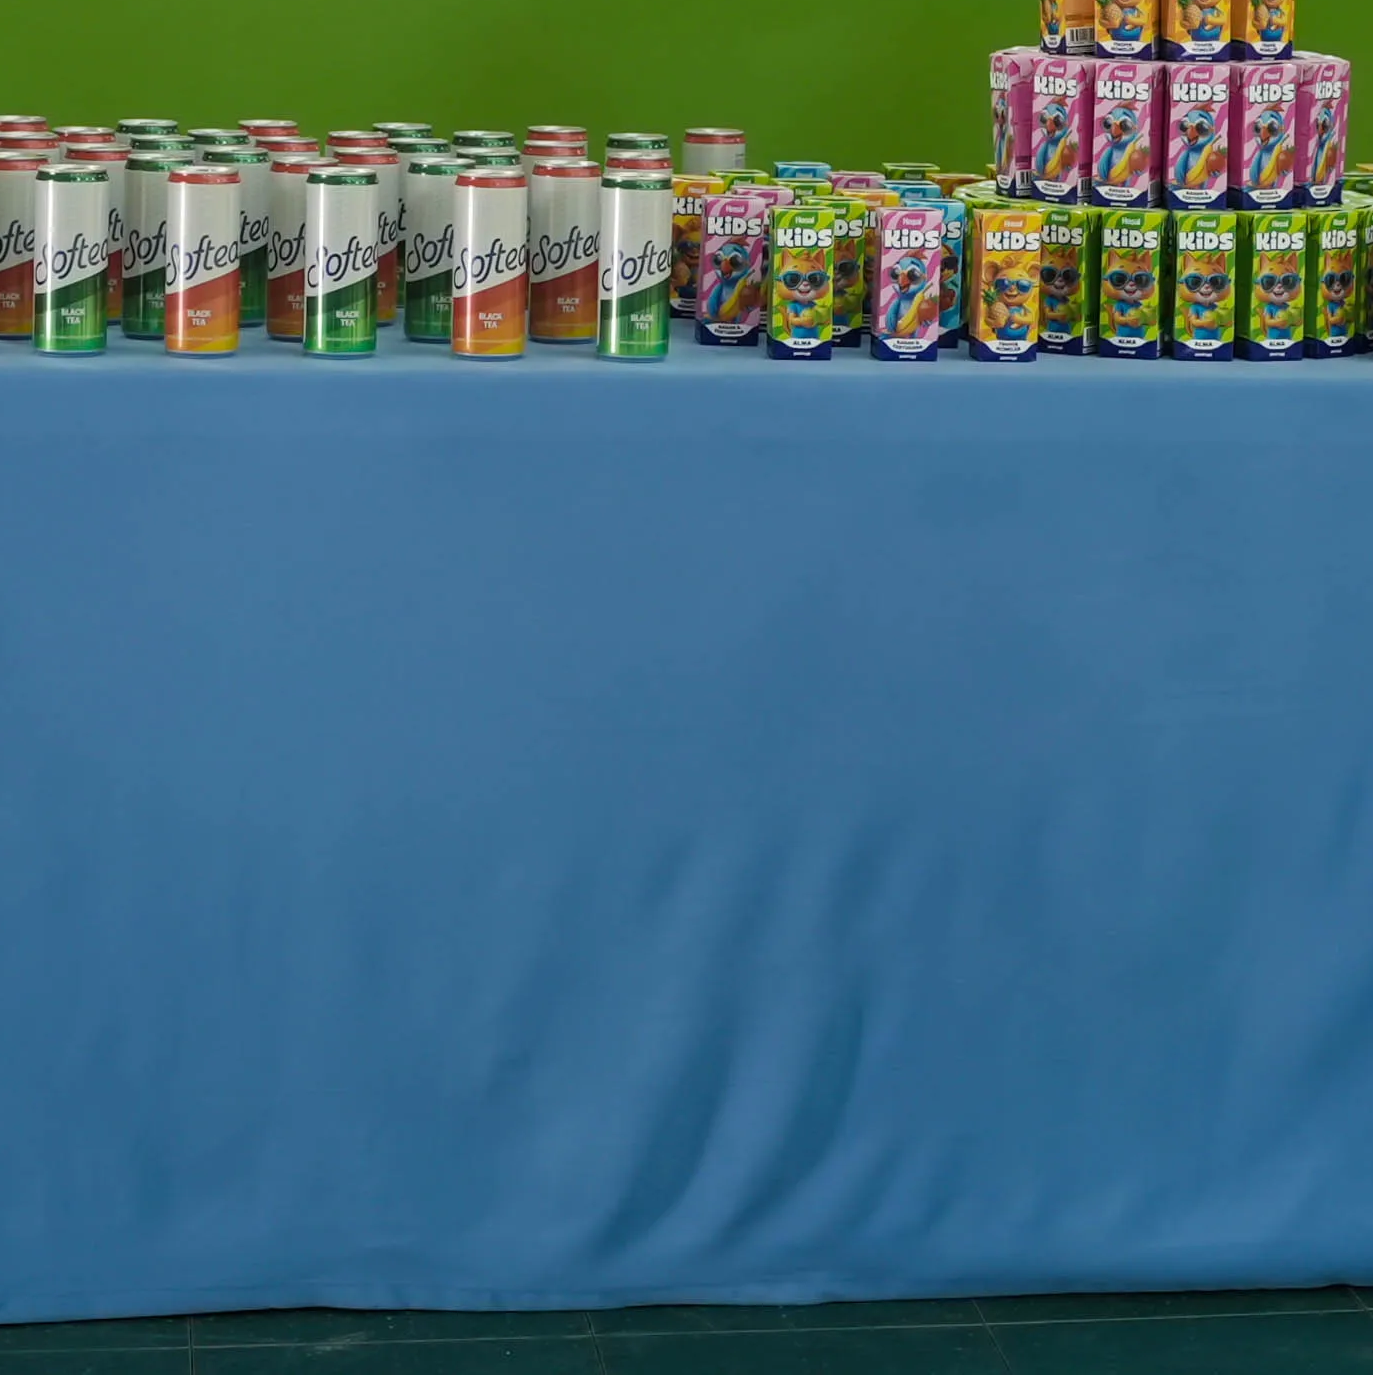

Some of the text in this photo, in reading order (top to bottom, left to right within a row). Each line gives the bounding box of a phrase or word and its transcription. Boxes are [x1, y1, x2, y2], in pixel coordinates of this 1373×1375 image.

[557, 296, 581, 305] BLACK
[61, 308, 85, 316] BLACK
[187, 310, 211, 318] BLACK
[336, 310, 360, 318] BLACK
[562, 305, 576, 314] TEA
[65, 315, 81, 324] TEA
[478, 312, 503, 320] BLACK
[630, 313, 654, 322] BLACK
[191, 317, 206, 326] TEA
[340, 318, 356, 326] TEA
[483, 320, 498, 329] TEA
[635, 321, 650, 330] TEA
